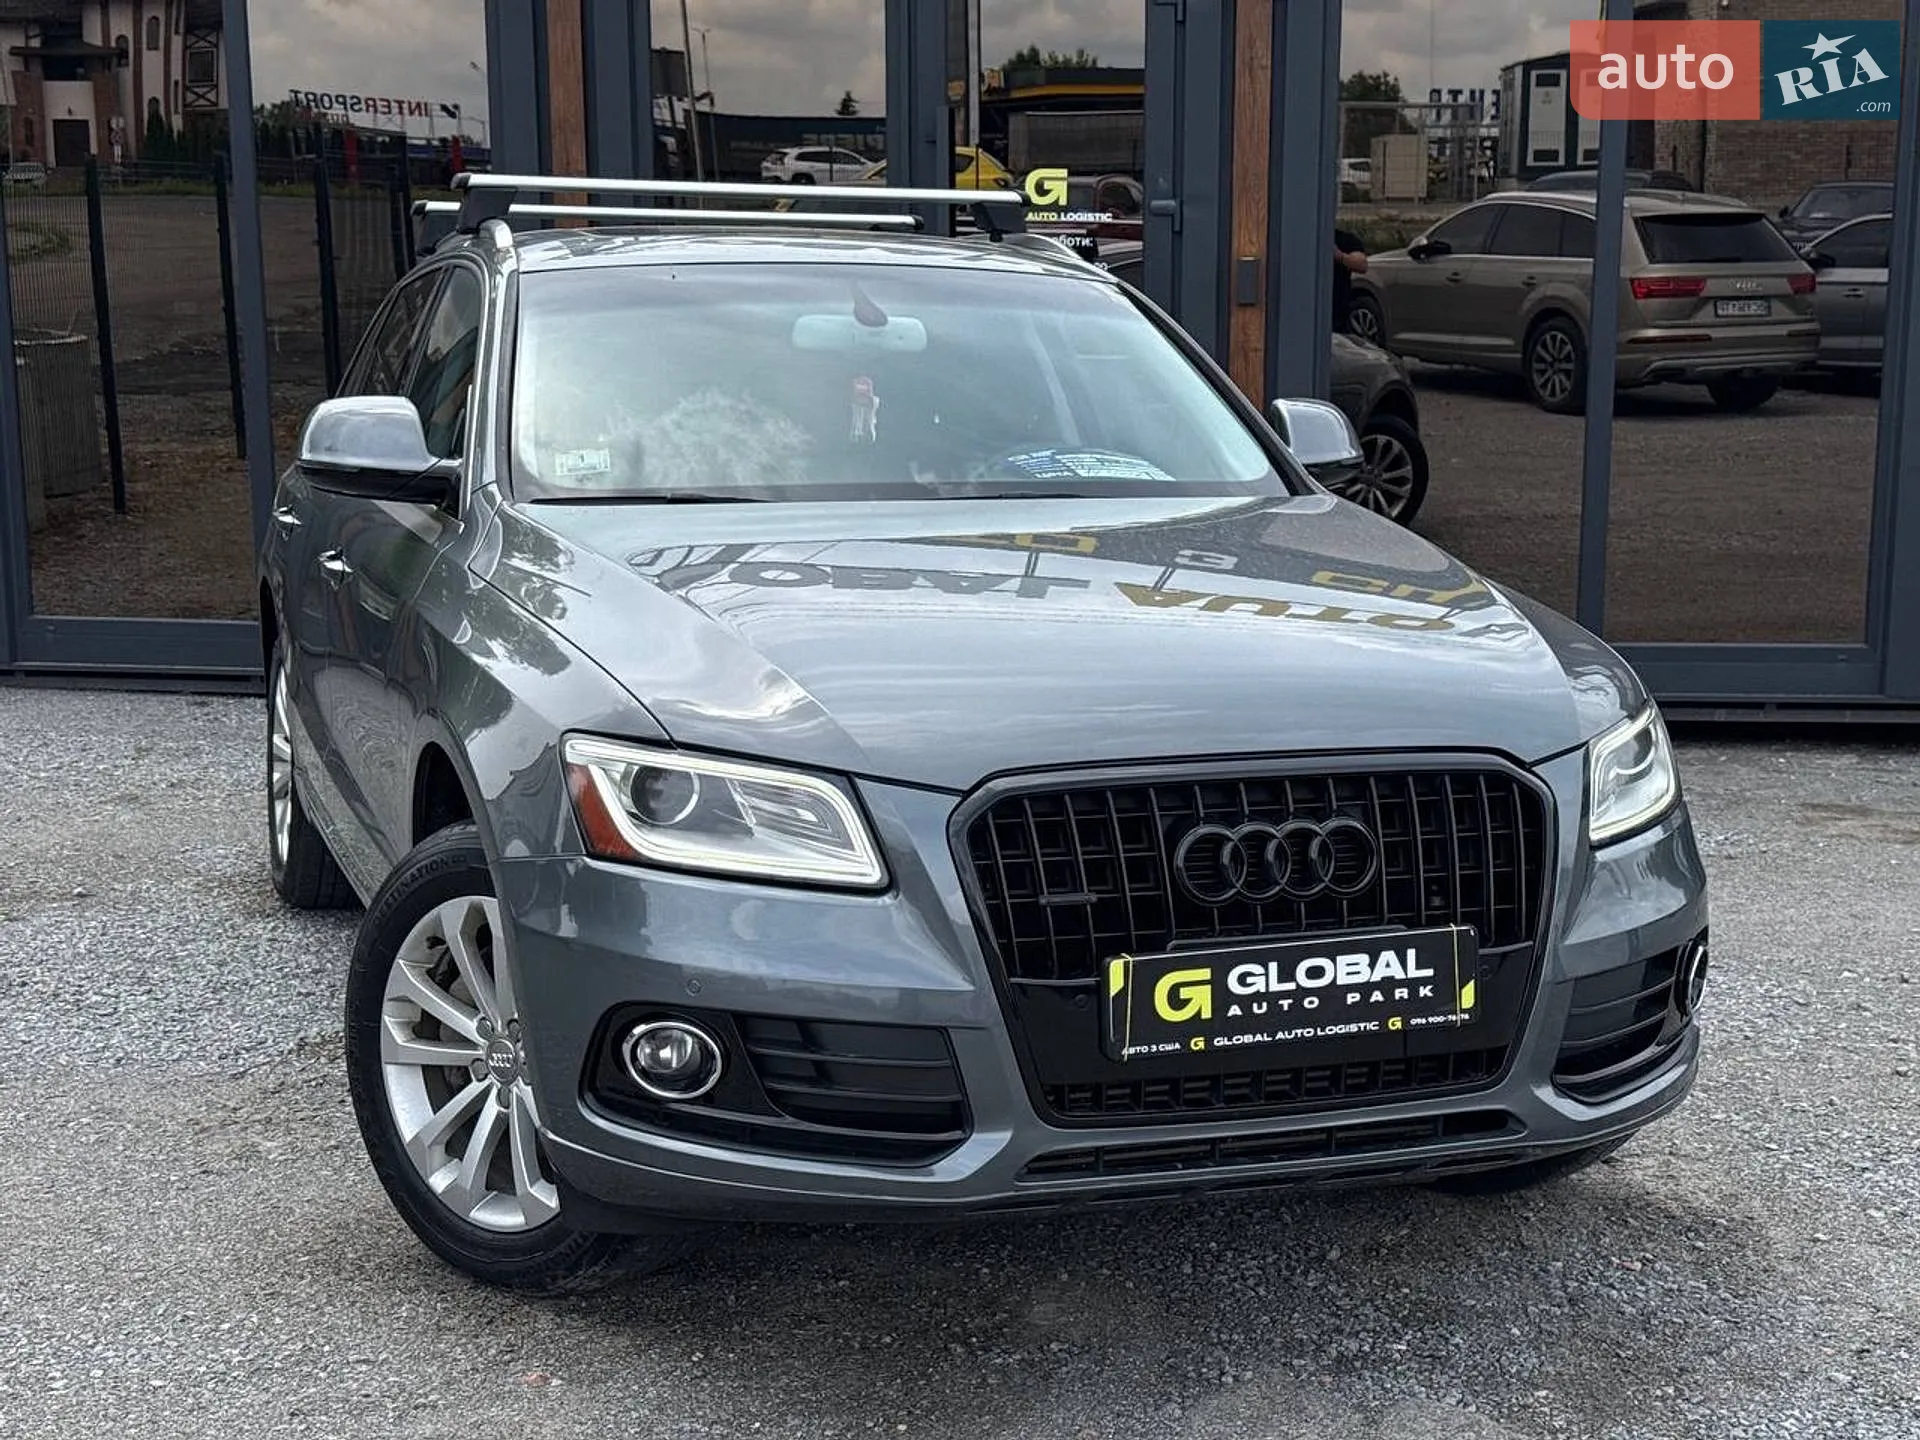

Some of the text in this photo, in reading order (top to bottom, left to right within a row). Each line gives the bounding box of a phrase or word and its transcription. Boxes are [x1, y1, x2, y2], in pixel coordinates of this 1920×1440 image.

[1025, 212, 1113, 221] AUTO LOGISTIC
[1227, 948, 1434, 995] GLOBAL
[1227, 985, 1434, 1017] AUTO PARK
[1213, 1033, 1273, 1047] GLOBAL
[1275, 1028, 1315, 1041] AUTO
[1317, 1021, 1380, 1036] LOGISTIC
